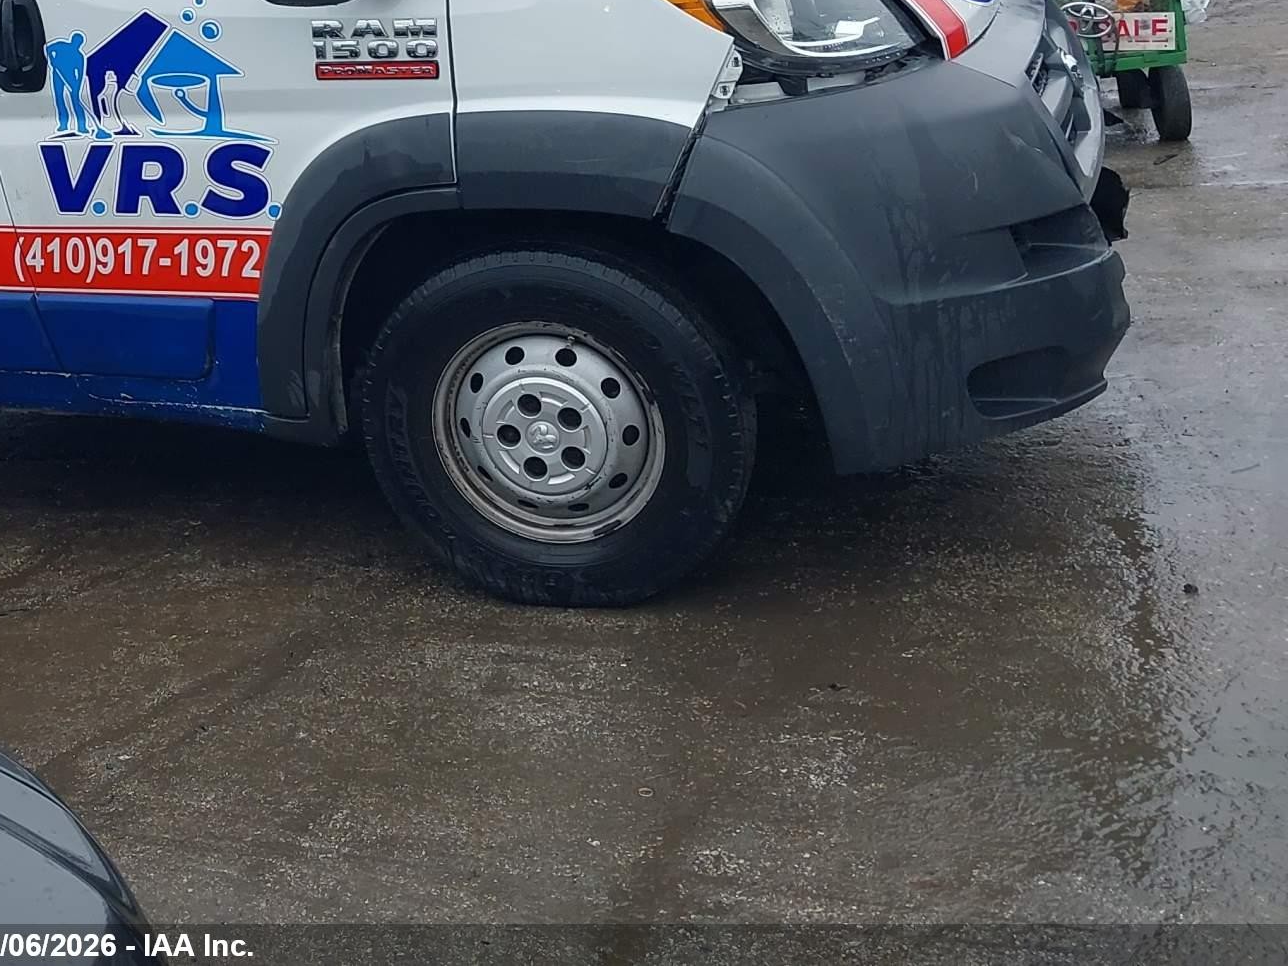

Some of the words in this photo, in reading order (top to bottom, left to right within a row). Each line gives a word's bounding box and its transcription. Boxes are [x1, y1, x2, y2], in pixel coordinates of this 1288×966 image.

[311, 18, 438, 39] RAM
[312, 39, 439, 59] 1500
[38, 140, 282, 219] V.R.S.
[14, 235, 262, 283] (410)917-1972
